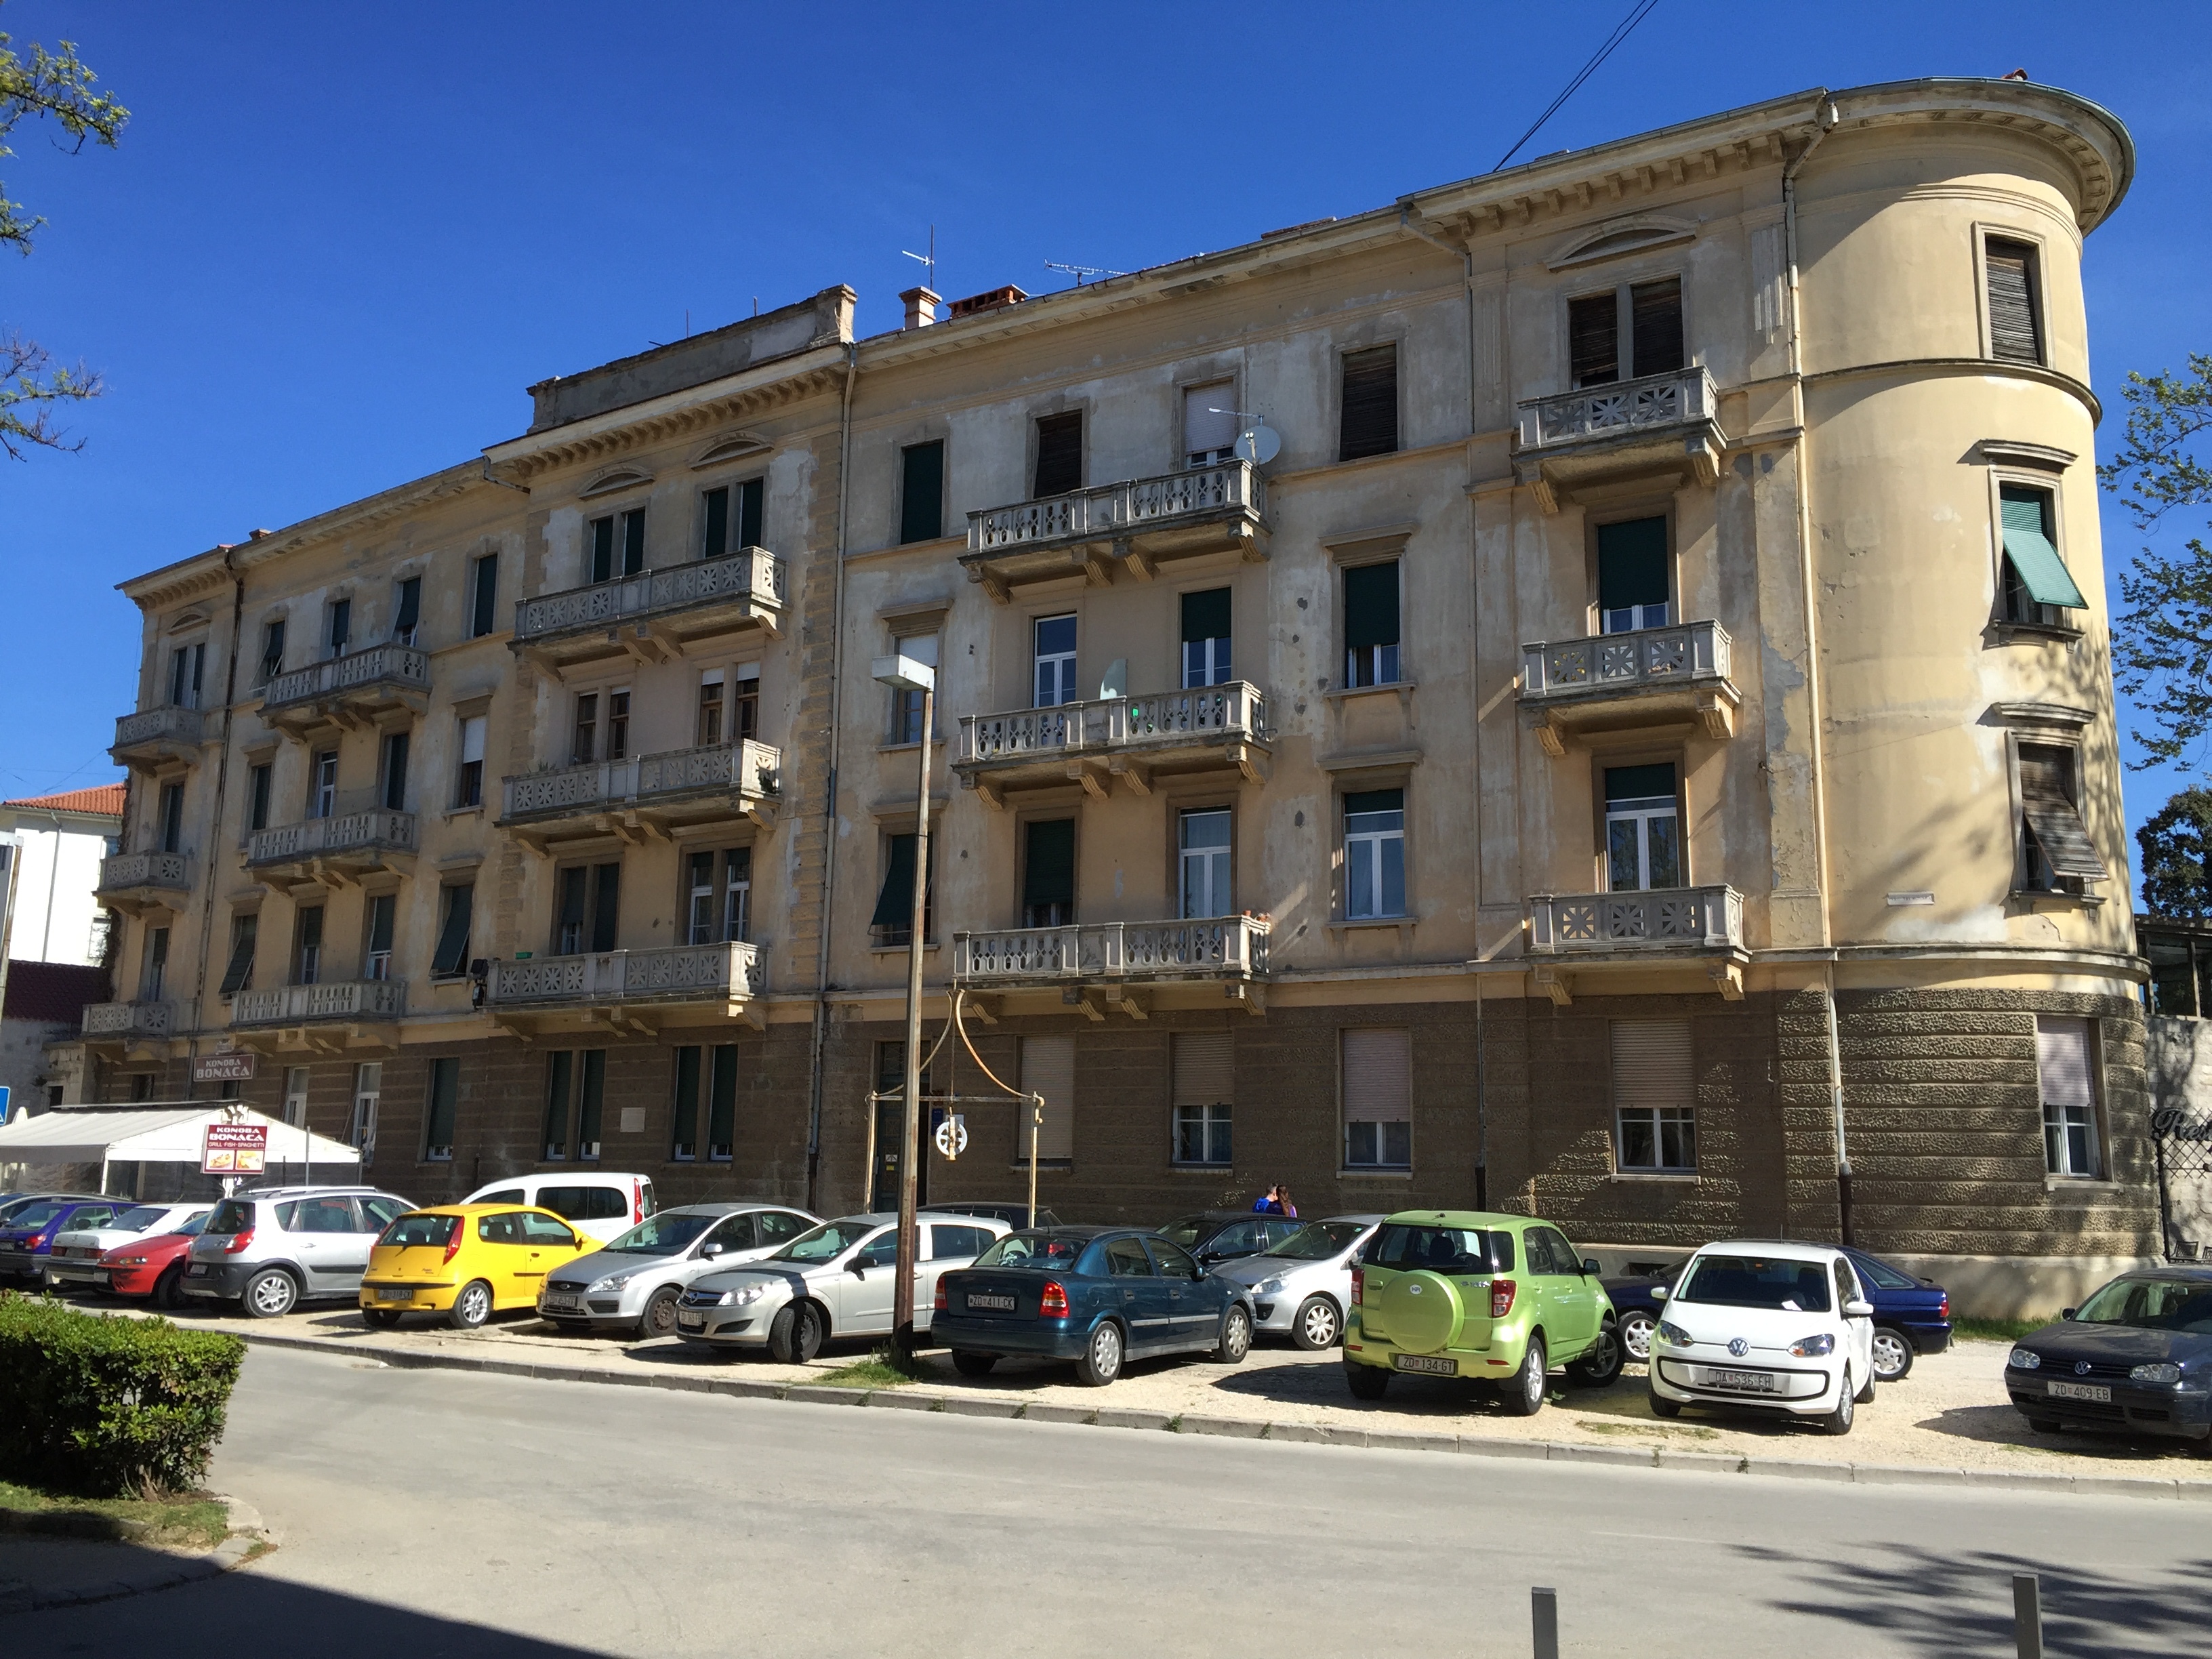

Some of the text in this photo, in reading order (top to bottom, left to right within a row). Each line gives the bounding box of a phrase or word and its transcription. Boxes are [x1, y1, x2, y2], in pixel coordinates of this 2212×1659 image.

[205, 1059, 241, 1067] KONOBA
[196, 1066, 250, 1079] BONACA
[209, 1133, 265, 1141] BONACA
[973, 1296, 982, 1306] ZD
[1404, 1357, 1453, 1372] ZD 134-GT
[1715, 1372, 1727, 1382] DA
[2054, 1384, 2109, 1399] ZD 409-EB
